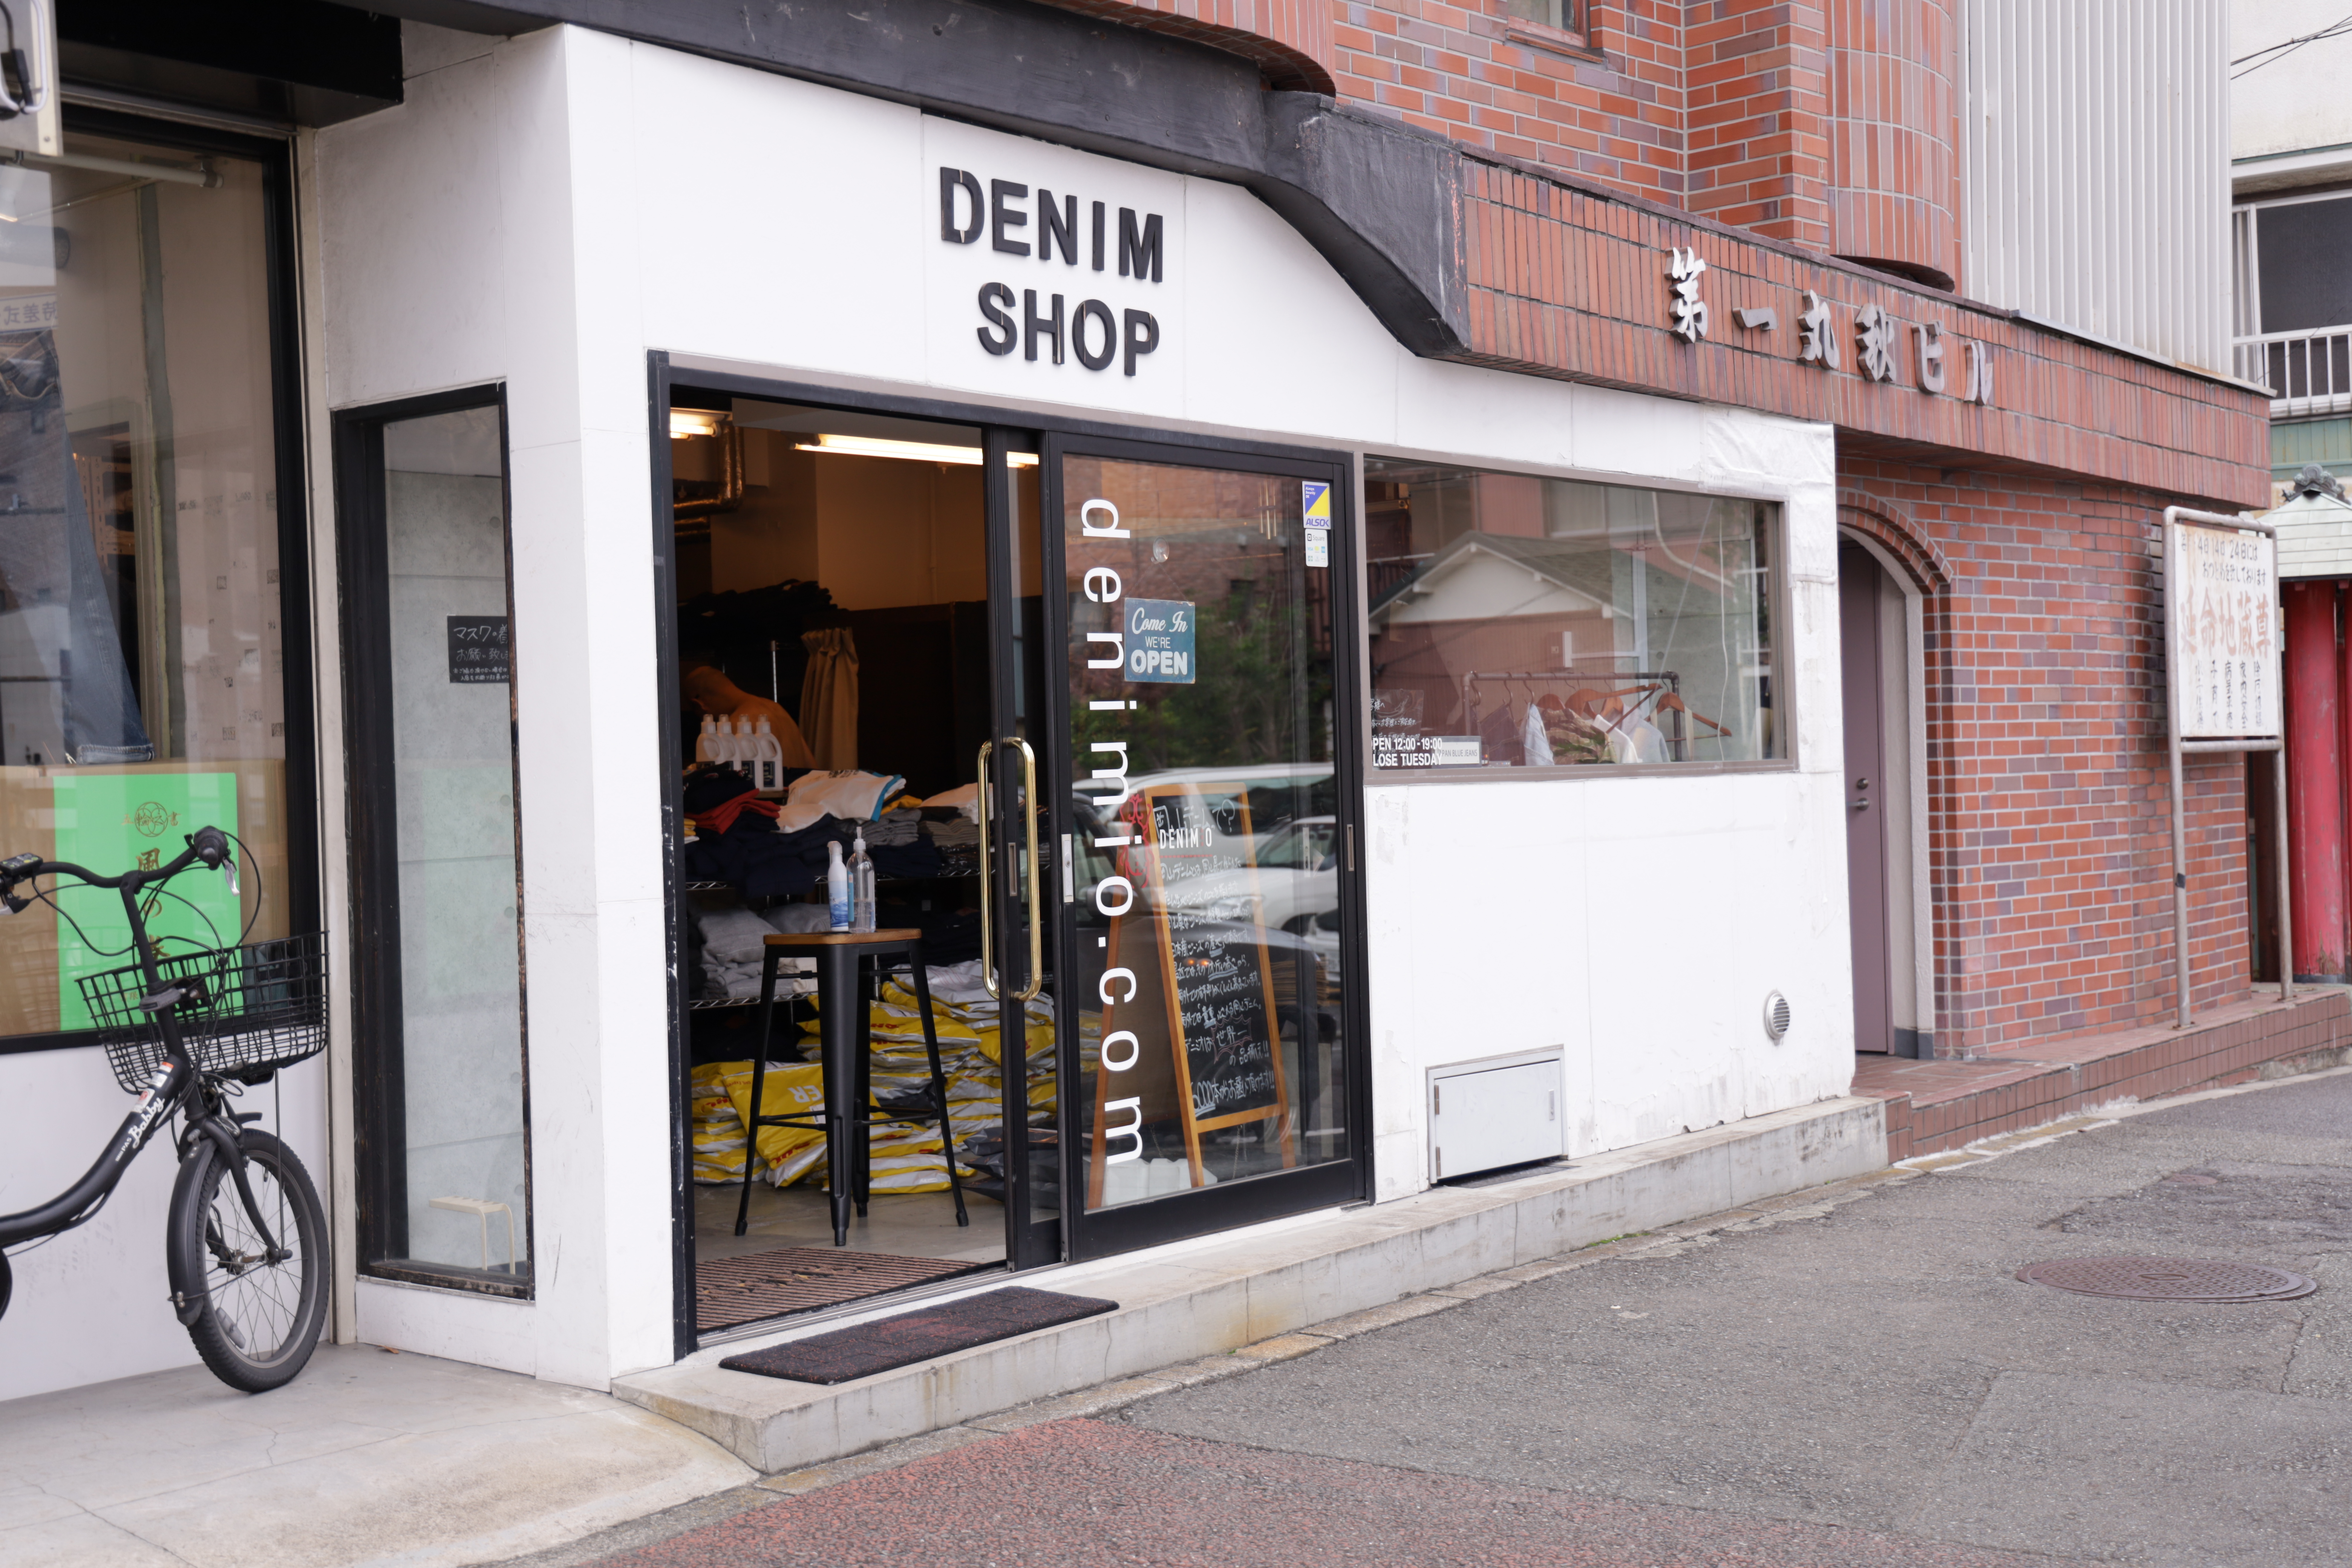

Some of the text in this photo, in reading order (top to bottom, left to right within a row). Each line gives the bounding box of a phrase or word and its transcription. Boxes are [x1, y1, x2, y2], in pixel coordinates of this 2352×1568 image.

[940, 167, 1163, 283] DENIM
[977, 282, 1159, 377] SHOP
[1306, 518, 1329, 527] ALSOK
[1132, 607, 1188, 634] Come In
[1145, 636, 1171, 648] WE'RE
[1131, 649, 1187, 675] OPEN
[1371, 737, 1392, 750] PEN
[1394, 738, 1416, 750] 12:00
[1421, 737, 1442, 750] 19:00
[1400, 753, 1442, 766] TUESDAY
[1081, 498, 1143, 1165] denimio.com
[1216, 1026, 1247, 1047] 世界一
[788, 1084, 824, 1103] ER
[128, 1097, 165, 1149] Babby
[121, 1137, 132, 1152] PAS
